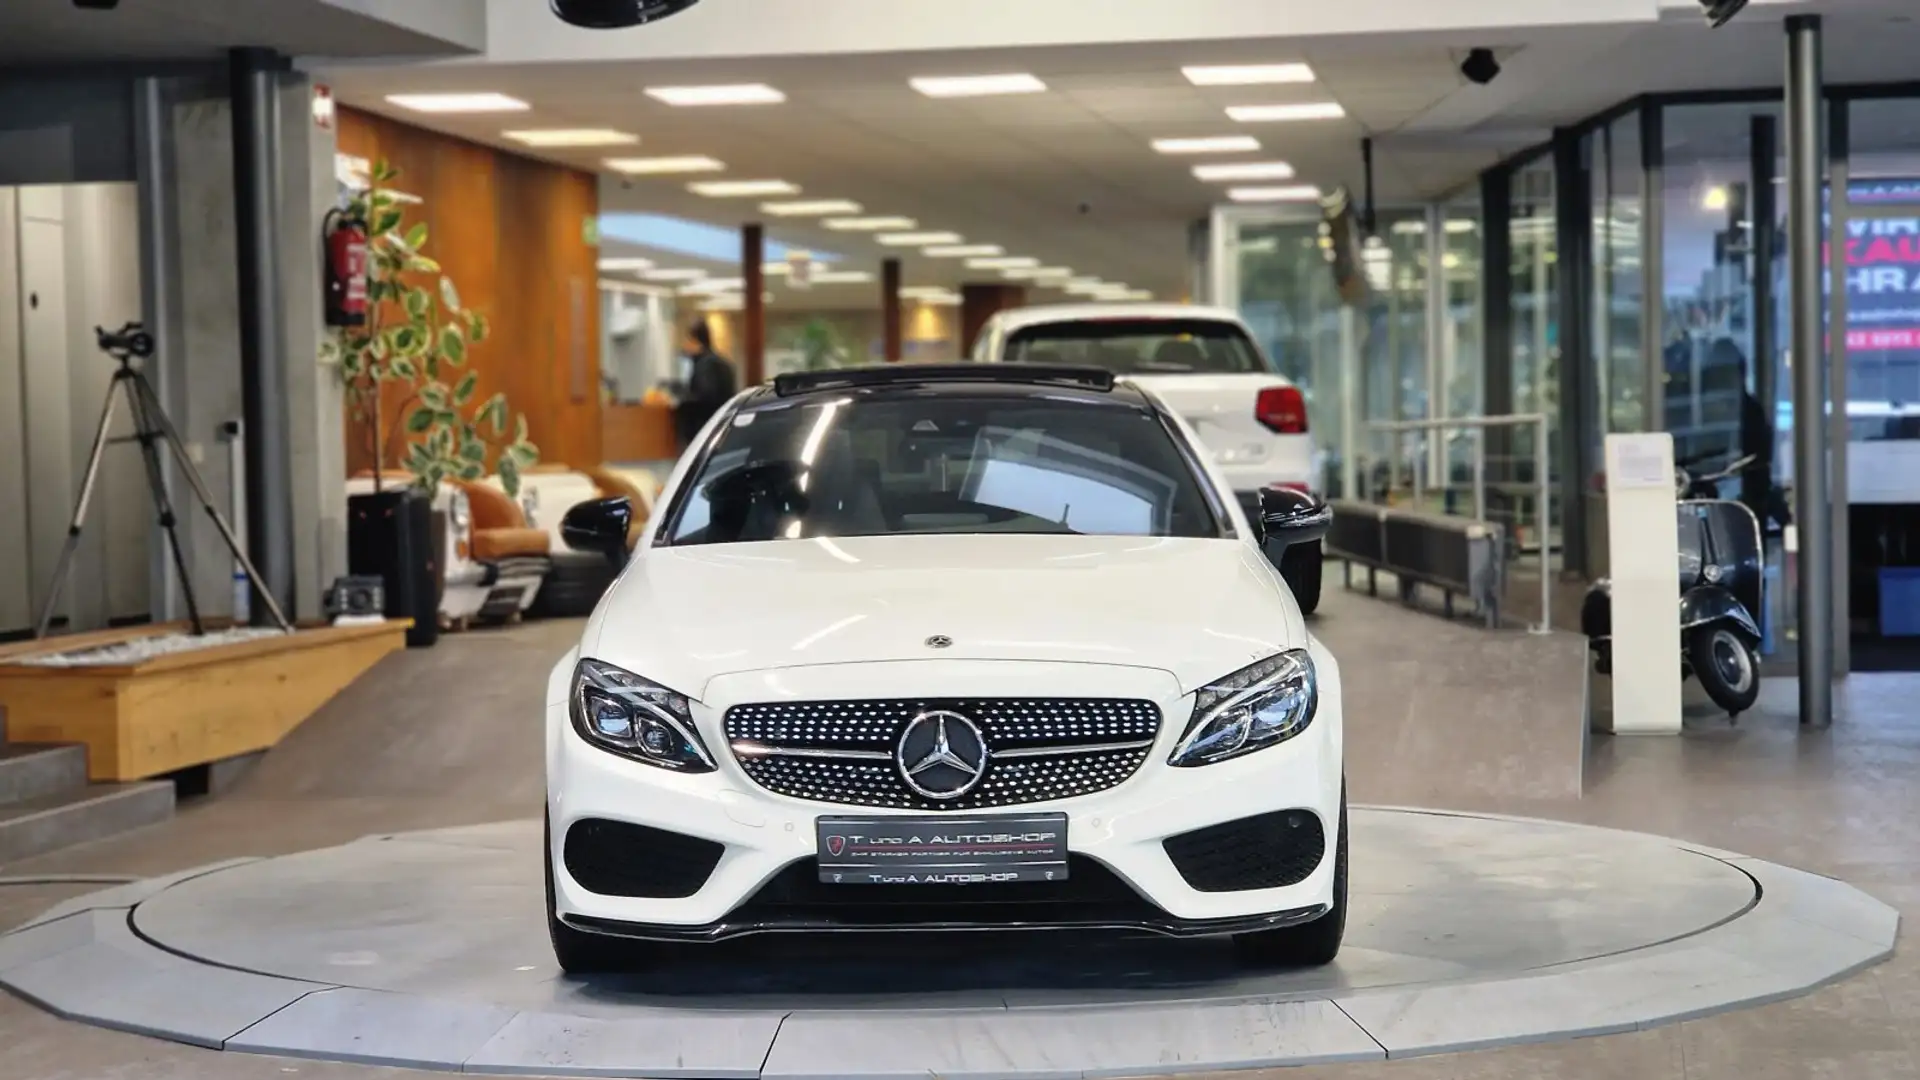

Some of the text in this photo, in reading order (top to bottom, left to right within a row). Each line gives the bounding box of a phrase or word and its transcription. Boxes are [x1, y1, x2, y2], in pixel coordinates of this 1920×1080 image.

[849, 835, 864, 844] T
[908, 835, 923, 844] A
[930, 833, 1057, 844] AUTOSHOP
[925, 872, 1018, 883] AUTOSHOP
